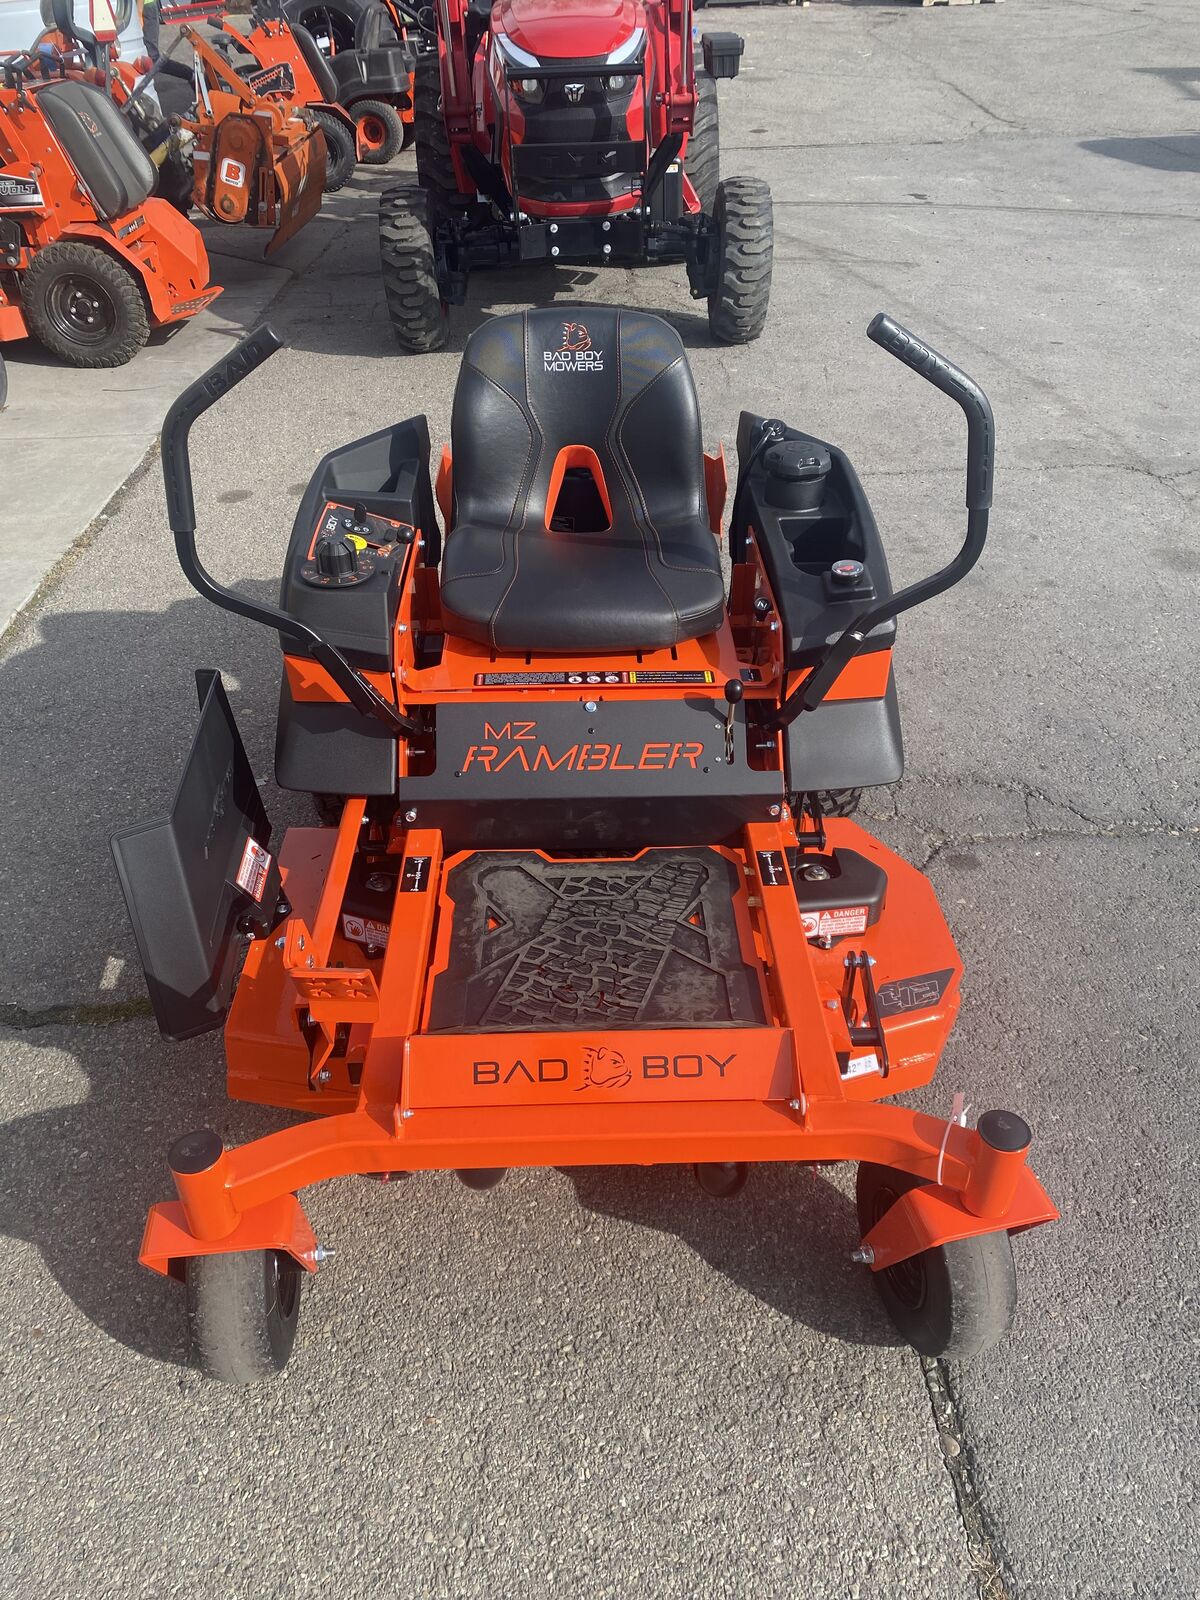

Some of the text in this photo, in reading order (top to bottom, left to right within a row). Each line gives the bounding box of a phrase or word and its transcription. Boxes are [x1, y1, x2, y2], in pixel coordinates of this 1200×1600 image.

[543, 350, 603, 361] BAD BOY
[883, 327, 950, 377] BOY
[543, 360, 604, 372] MOWERS
[484, 721, 537, 740] MZ
[461, 741, 705, 773] RAMBLER
[833, 908, 866, 918] DANGER
[472, 1053, 738, 1085] BAD BOY
